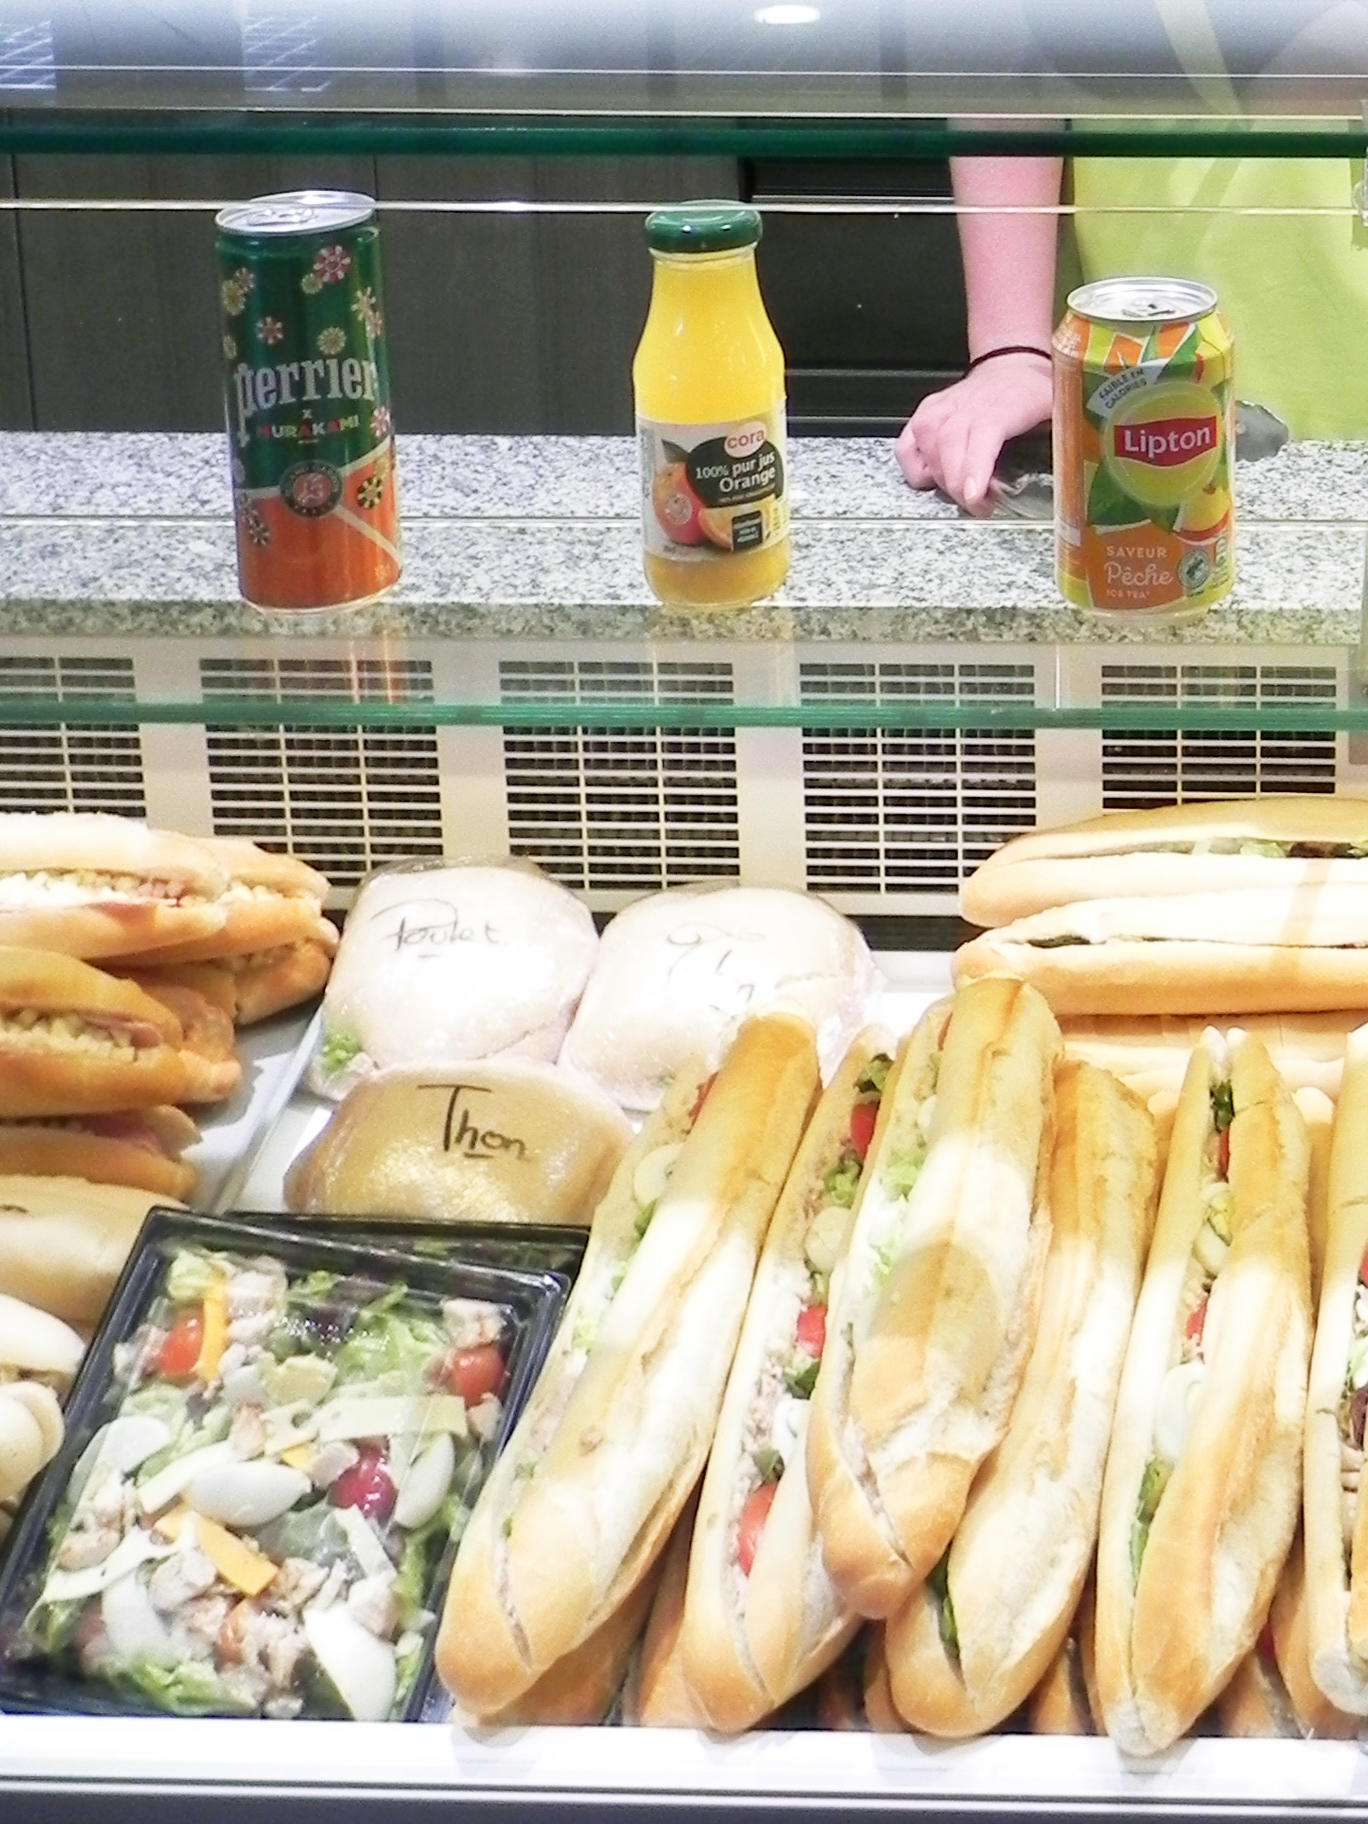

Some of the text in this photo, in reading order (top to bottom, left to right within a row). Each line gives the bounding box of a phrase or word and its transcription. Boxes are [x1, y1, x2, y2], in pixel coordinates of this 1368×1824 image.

[1105, 378, 1148, 409] CALORIES
[727, 429, 765, 449] cora
[1124, 426, 1211, 458] Lipton
[695, 451, 776, 480] 100% pur jus
[719, 468, 776, 493] Orange
[1106, 545, 1168, 559] SAVEUR
[1104, 561, 1174, 587] Pêche
[417, 1083, 527, 1160] Thon
